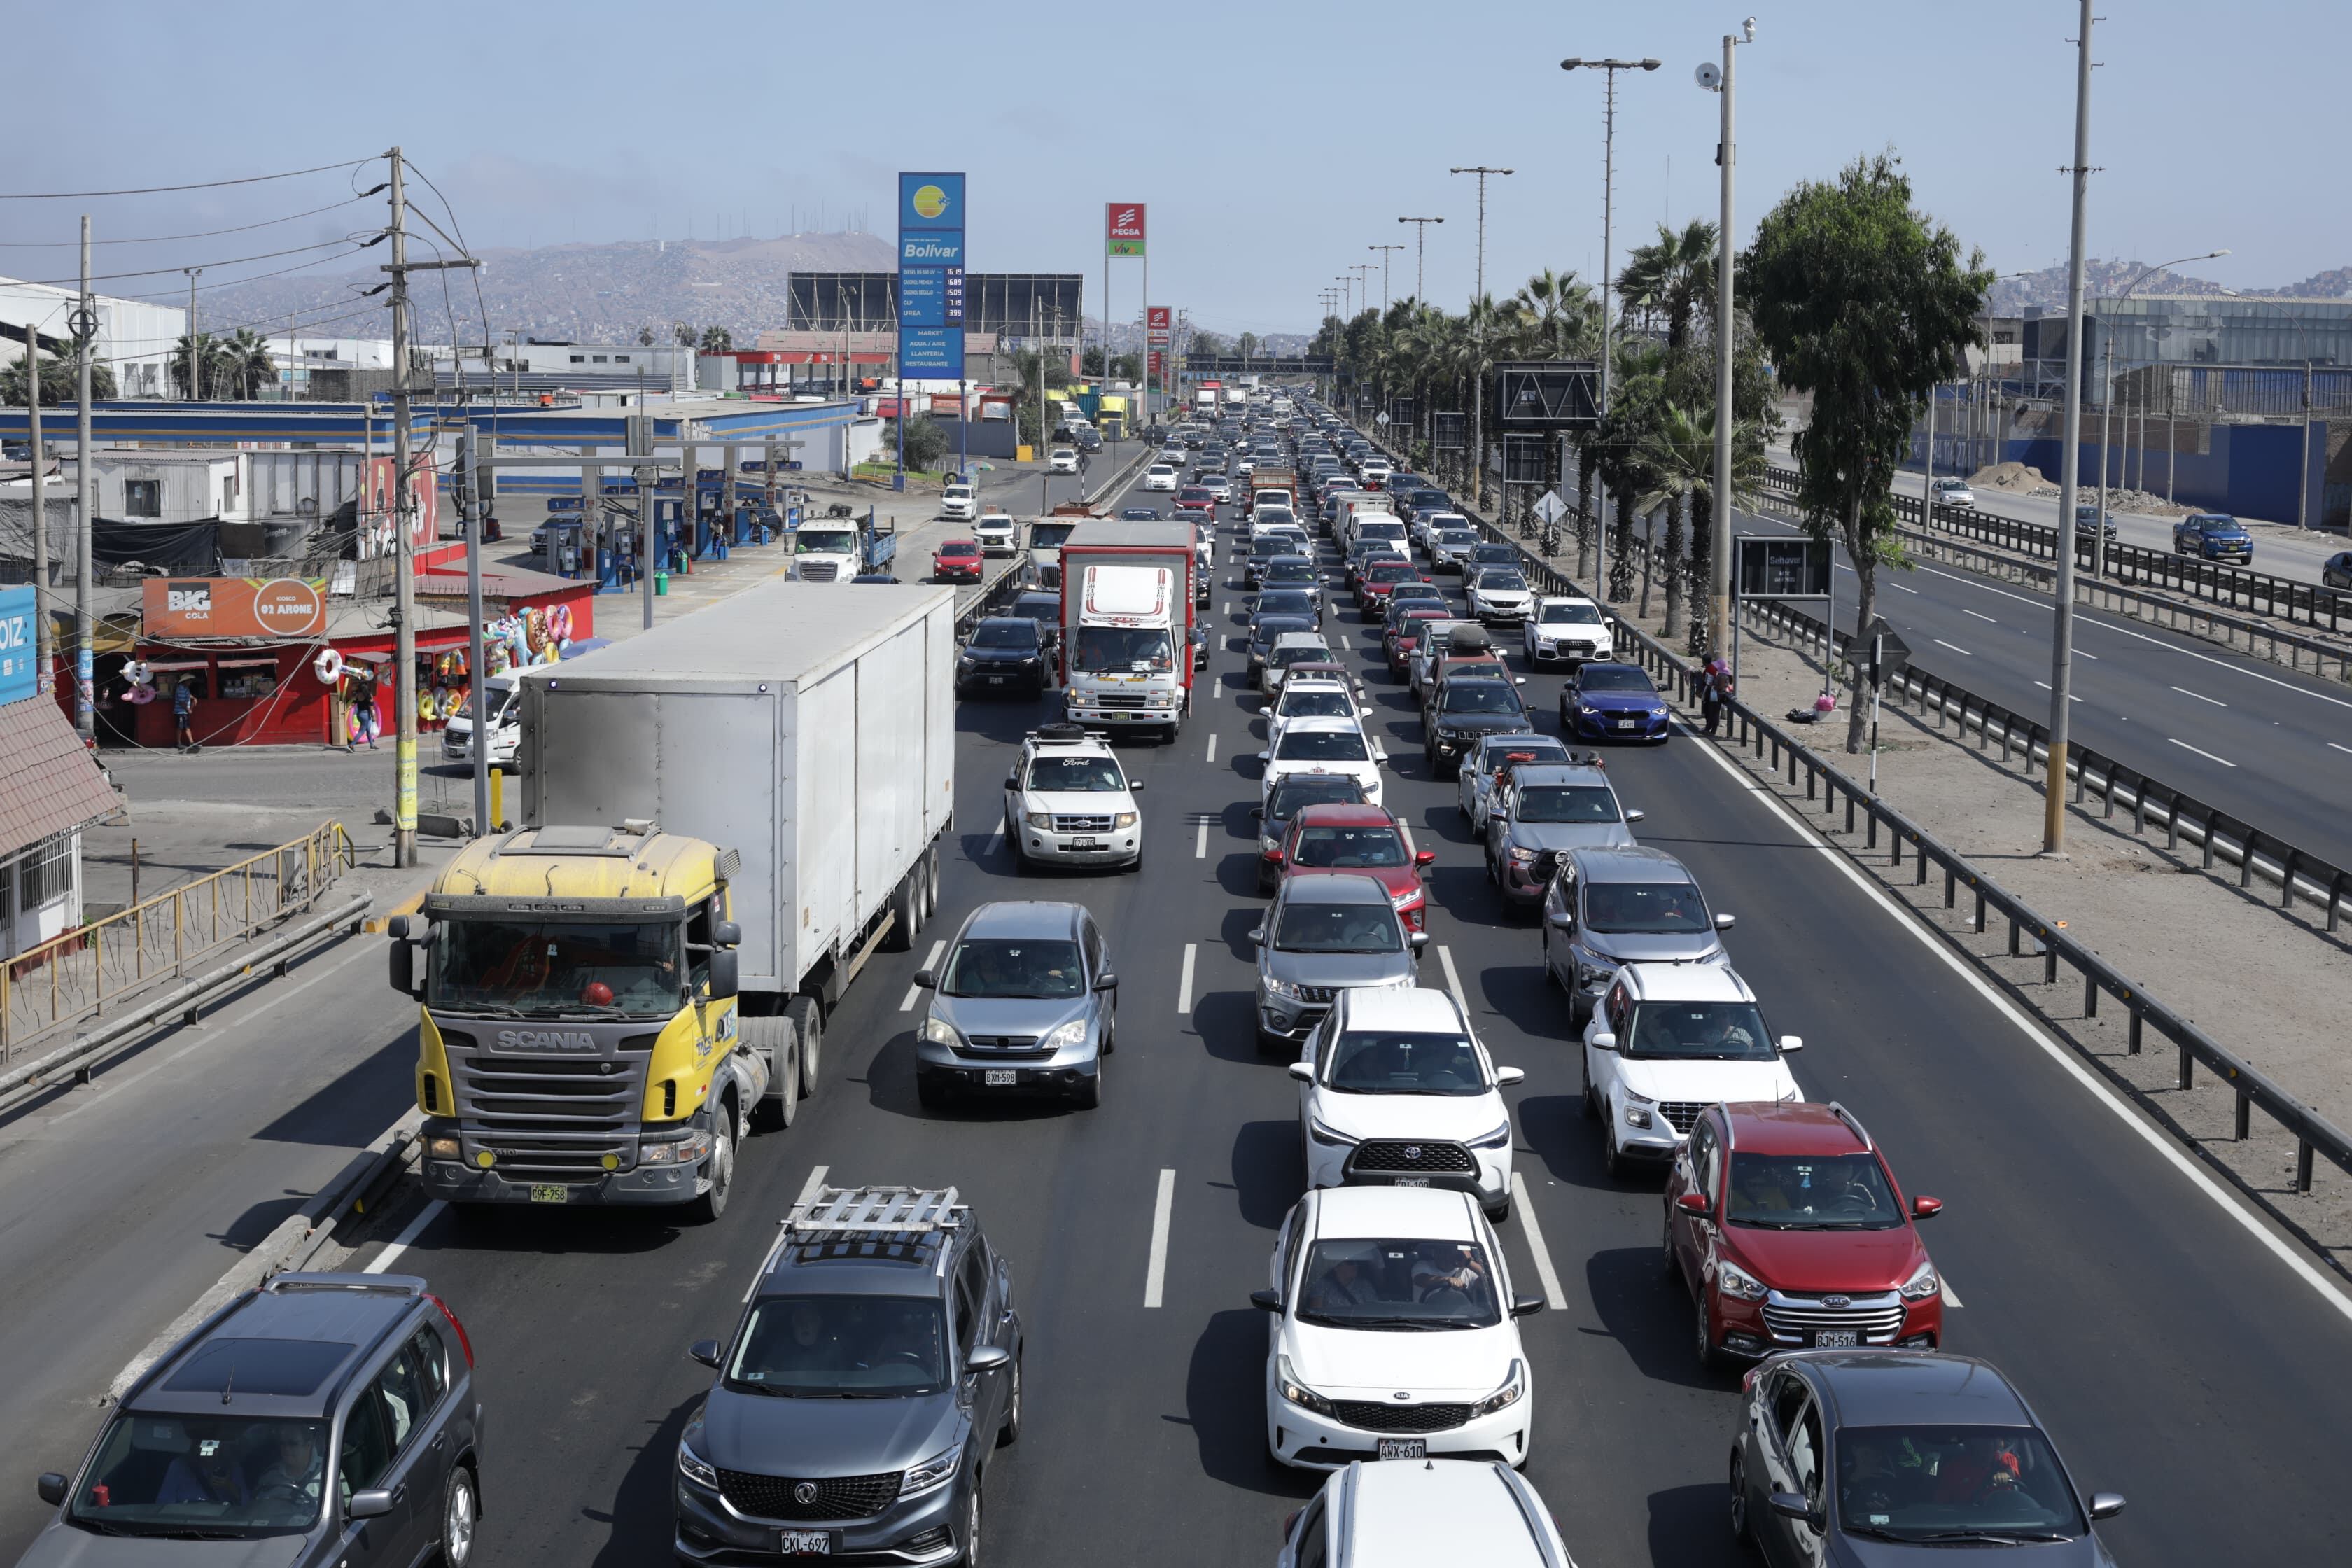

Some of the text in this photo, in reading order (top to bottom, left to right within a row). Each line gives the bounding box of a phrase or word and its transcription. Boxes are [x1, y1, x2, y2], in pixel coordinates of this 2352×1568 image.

[904, 244, 958, 258] Bolívar
[168, 590, 211, 611] BIG
[277, 604, 313, 614] ARONE
[1063, 758, 1090, 766] Ford
[497, 1031, 595, 1049] SCANIA
[987, 1073, 1015, 1082] BXM-598
[532, 1189, 565, 1200] C9F-758
[1818, 1336, 1855, 1347] BJM-516
[1381, 1446, 1423, 1458] AWX-610
[783, 1538, 828, 1552] CKL-697
